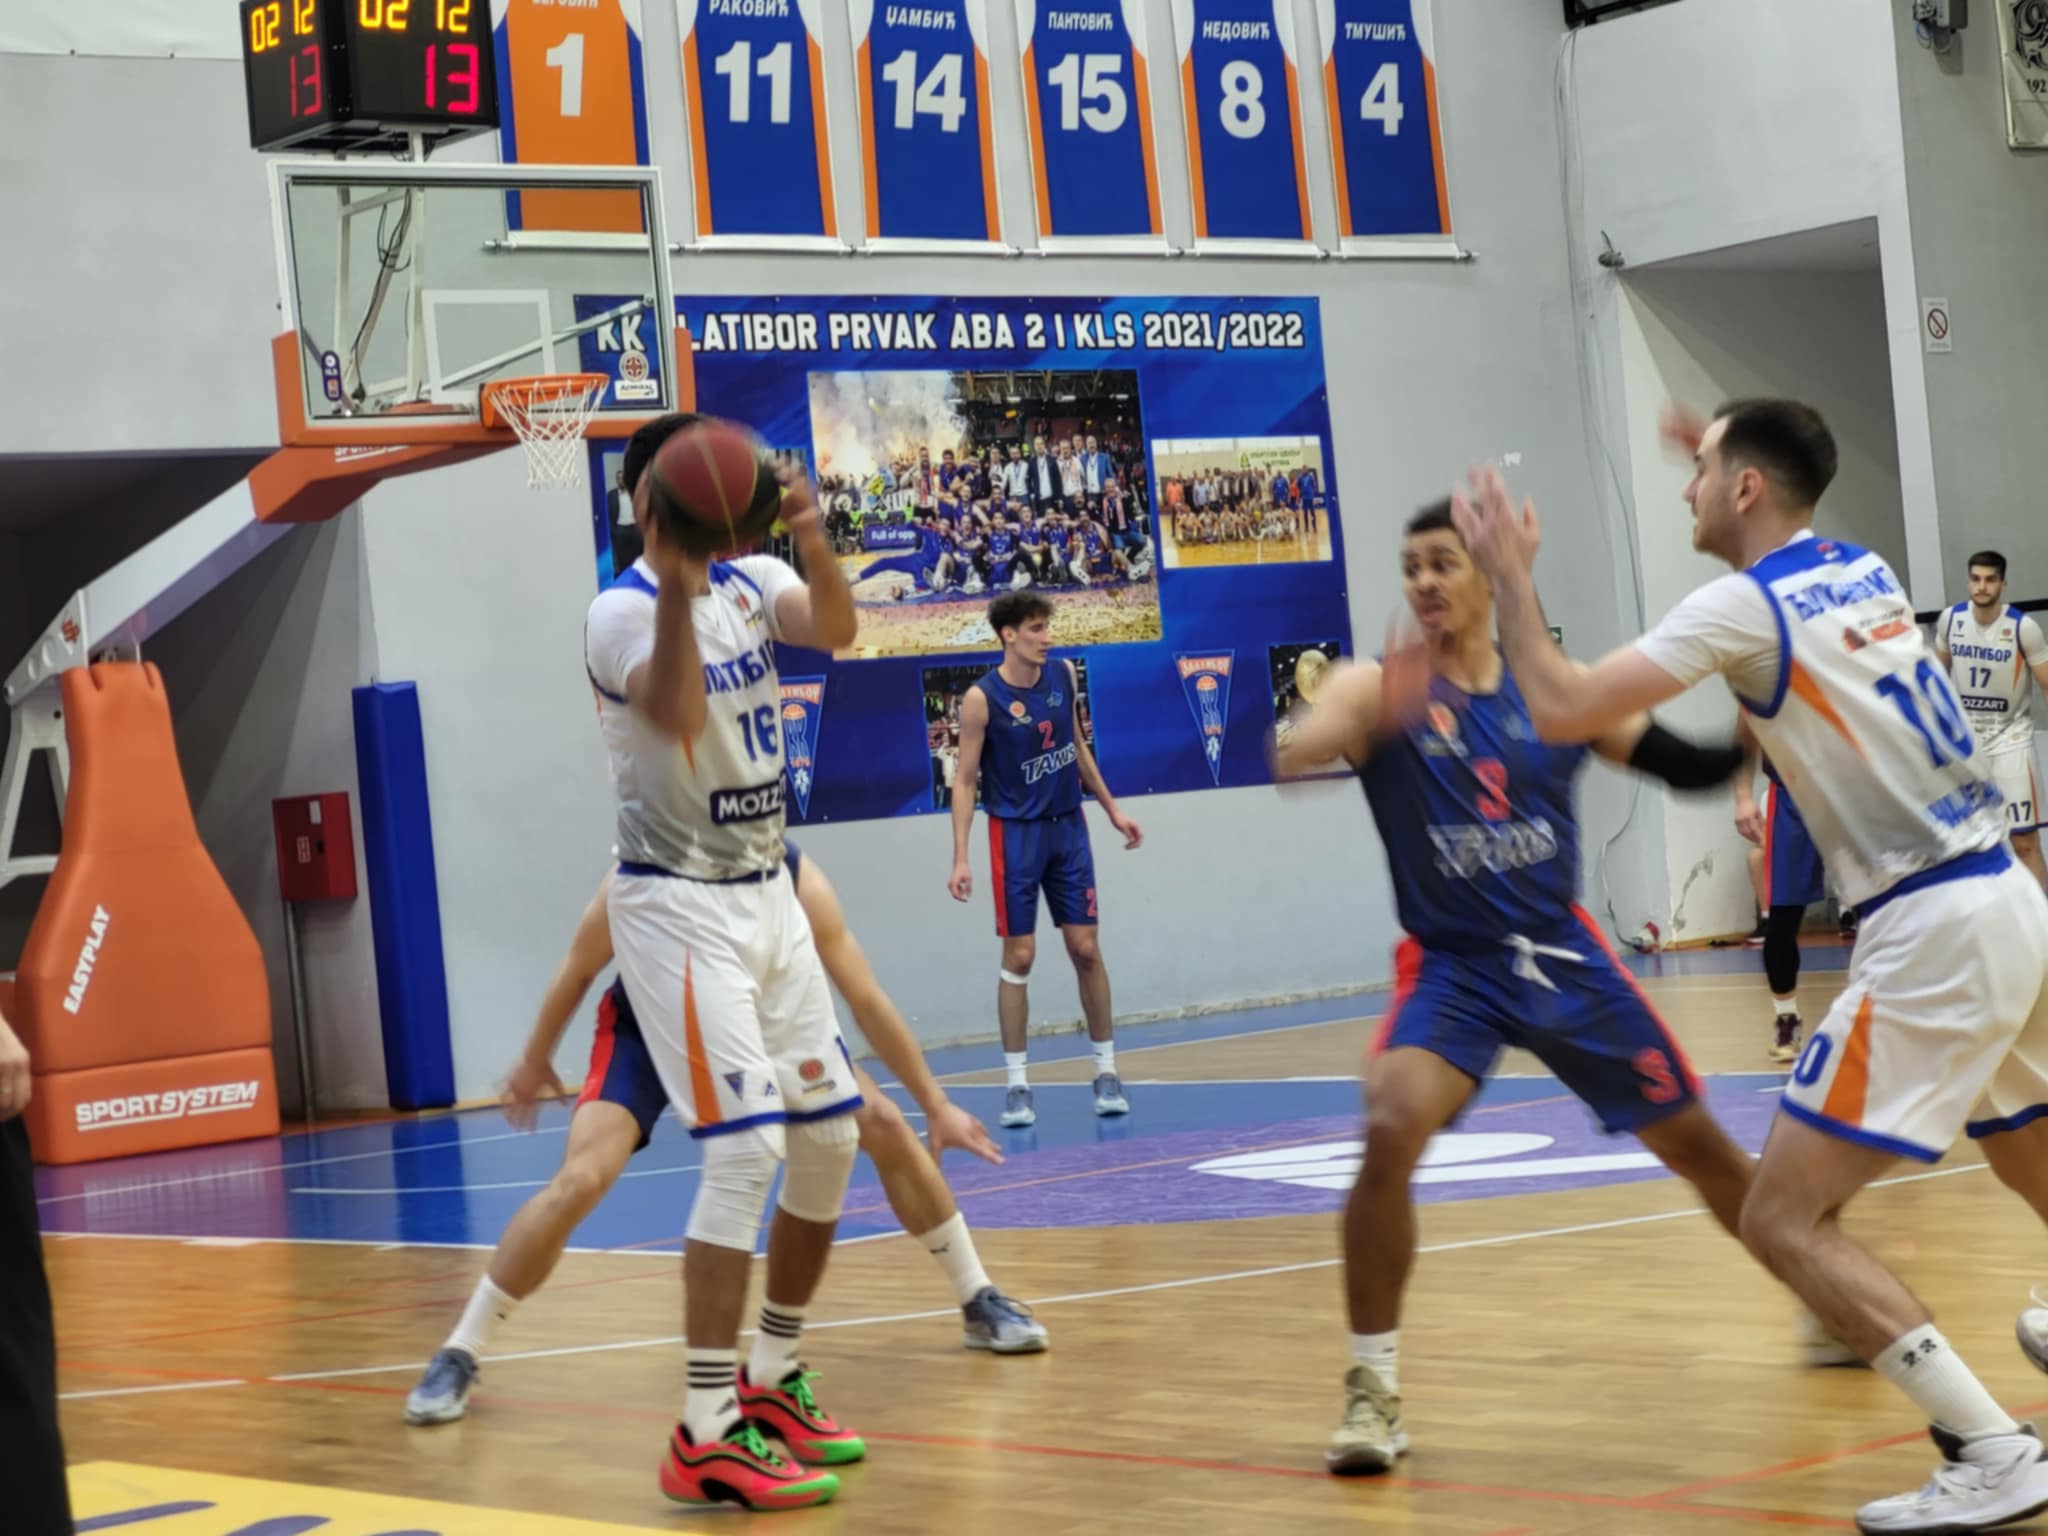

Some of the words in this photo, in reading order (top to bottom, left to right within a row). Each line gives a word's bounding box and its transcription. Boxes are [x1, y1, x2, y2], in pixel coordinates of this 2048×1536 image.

[251, 2, 280, 53] 02
[1048, 12, 1113, 31] ПАНТОВИЋ
[1202, 20, 1270, 42] НЕДОВИЋ
[289, 43, 322, 118] 13
[425, 43, 479, 114] 13
[545, 33, 584, 117] 1
[715, 40, 792, 124] 11
[882, 50, 966, 133] 14
[1048, 53, 1127, 133] 15
[1219, 60, 1266, 139] 8
[1360, 62, 1404, 136] 4
[676, 312, 819, 351] LATIBOR
[828, 313, 938, 350] PRVAK
[950, 313, 1016, 349] ABA
[1024, 313, 1046, 349] 2
[1054, 313, 1066, 349] I
[1073, 313, 1136, 349] KLS
[1143, 313, 1304, 351] 2021/2022
[1962, 698, 2006, 710] OZZART
[1969, 666, 1992, 689] 17
[736, 705, 778, 762] 16
[1038, 720, 1055, 749] 2
[718, 775, 786, 820] MOZZ
[2010, 801, 2031, 822] 17
[63, 904, 110, 1014] EASYPLAY
